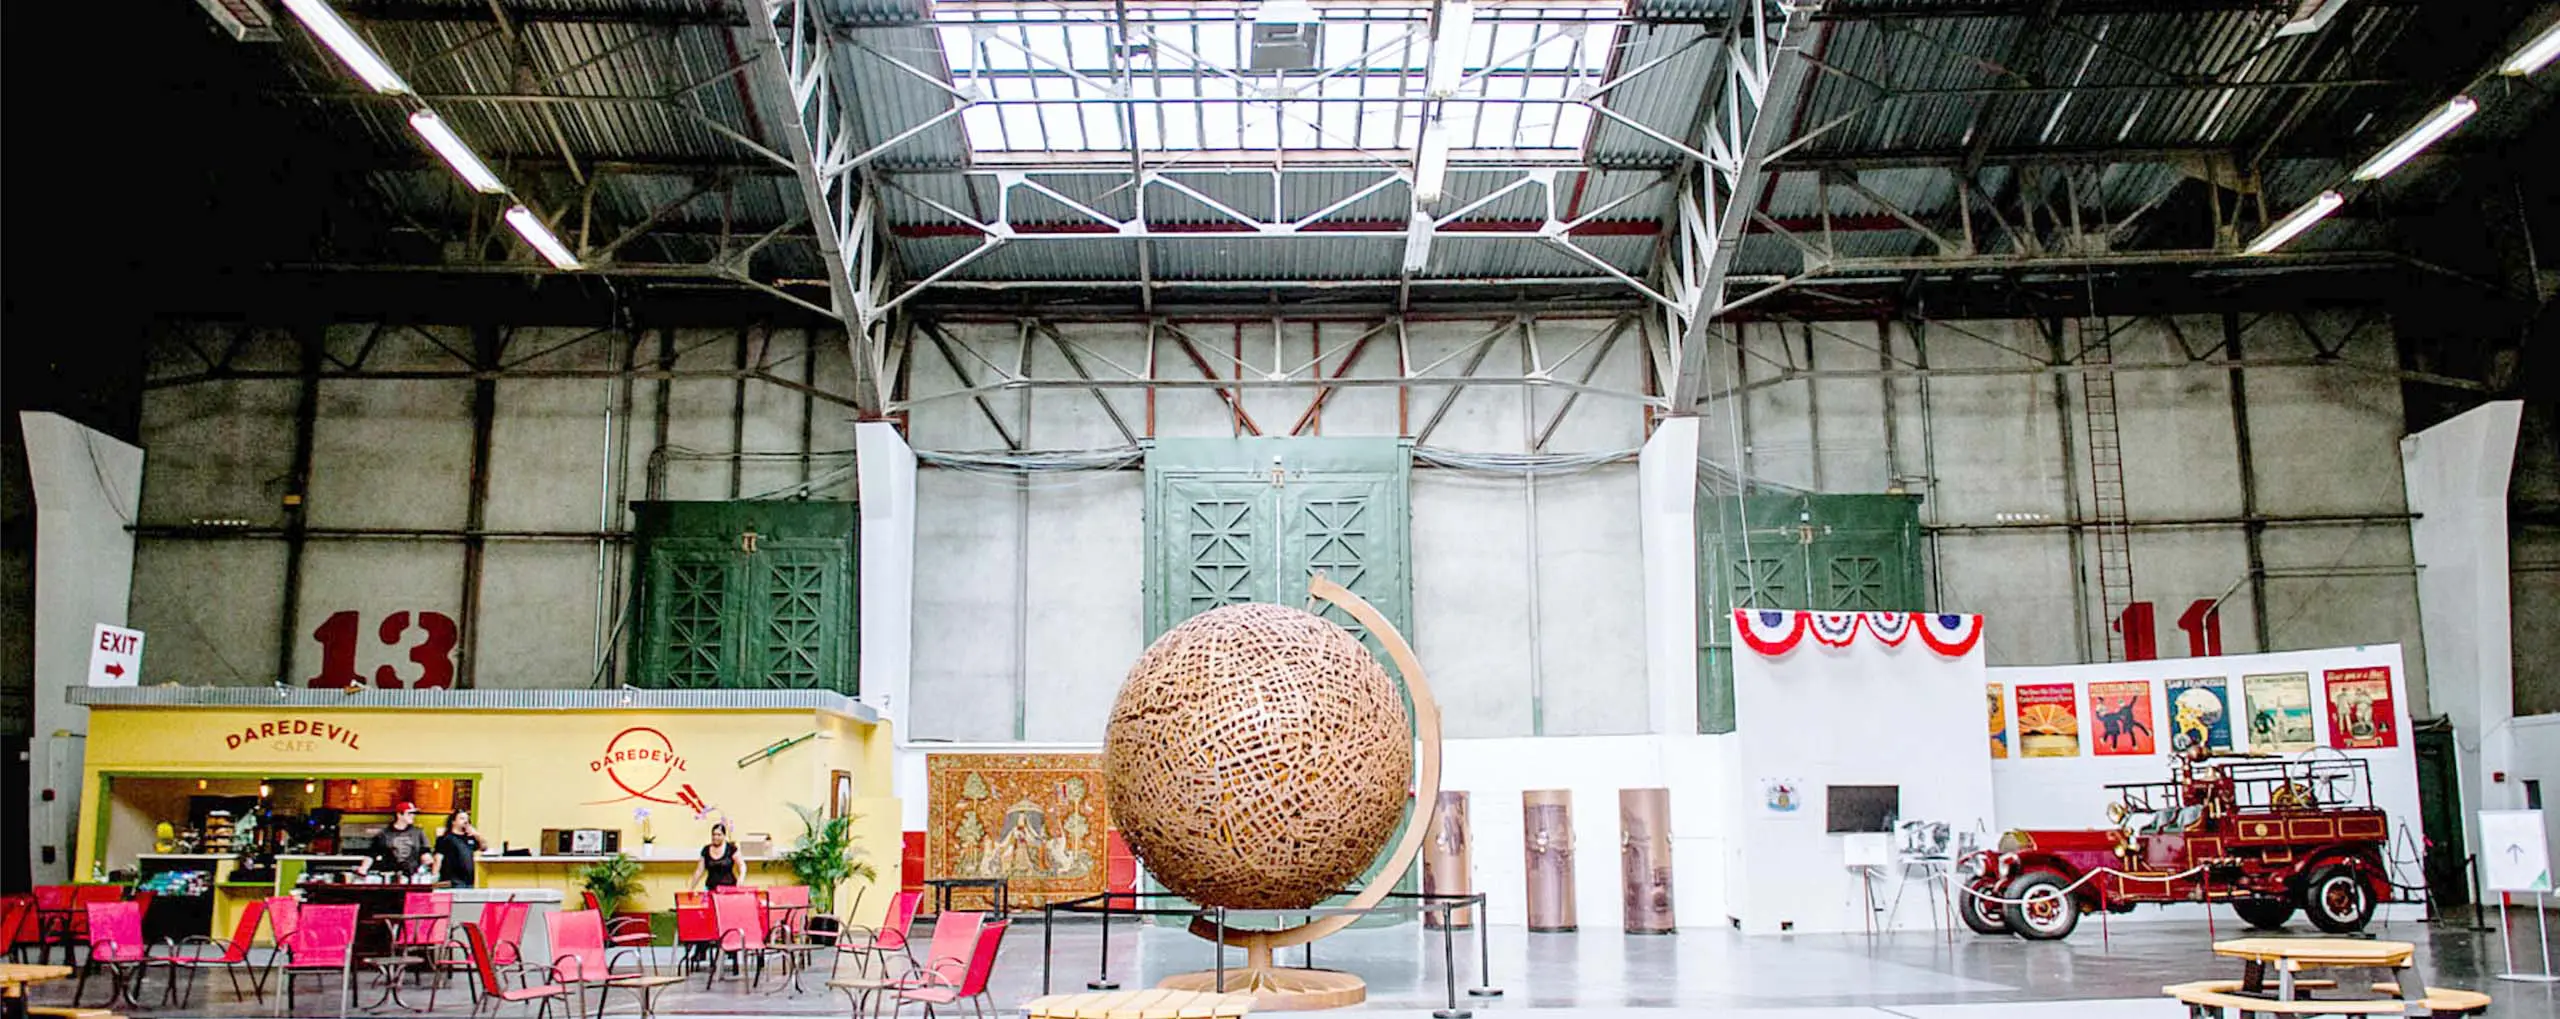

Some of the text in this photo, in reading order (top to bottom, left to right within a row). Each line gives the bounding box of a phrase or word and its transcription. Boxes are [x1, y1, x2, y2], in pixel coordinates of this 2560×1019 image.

[100, 630, 138, 656] EXIT
[308, 610, 457, 689] 13
[226, 719, 360, 750] DAREDEVIL
[590, 748, 687, 772] DAREDEVIL
